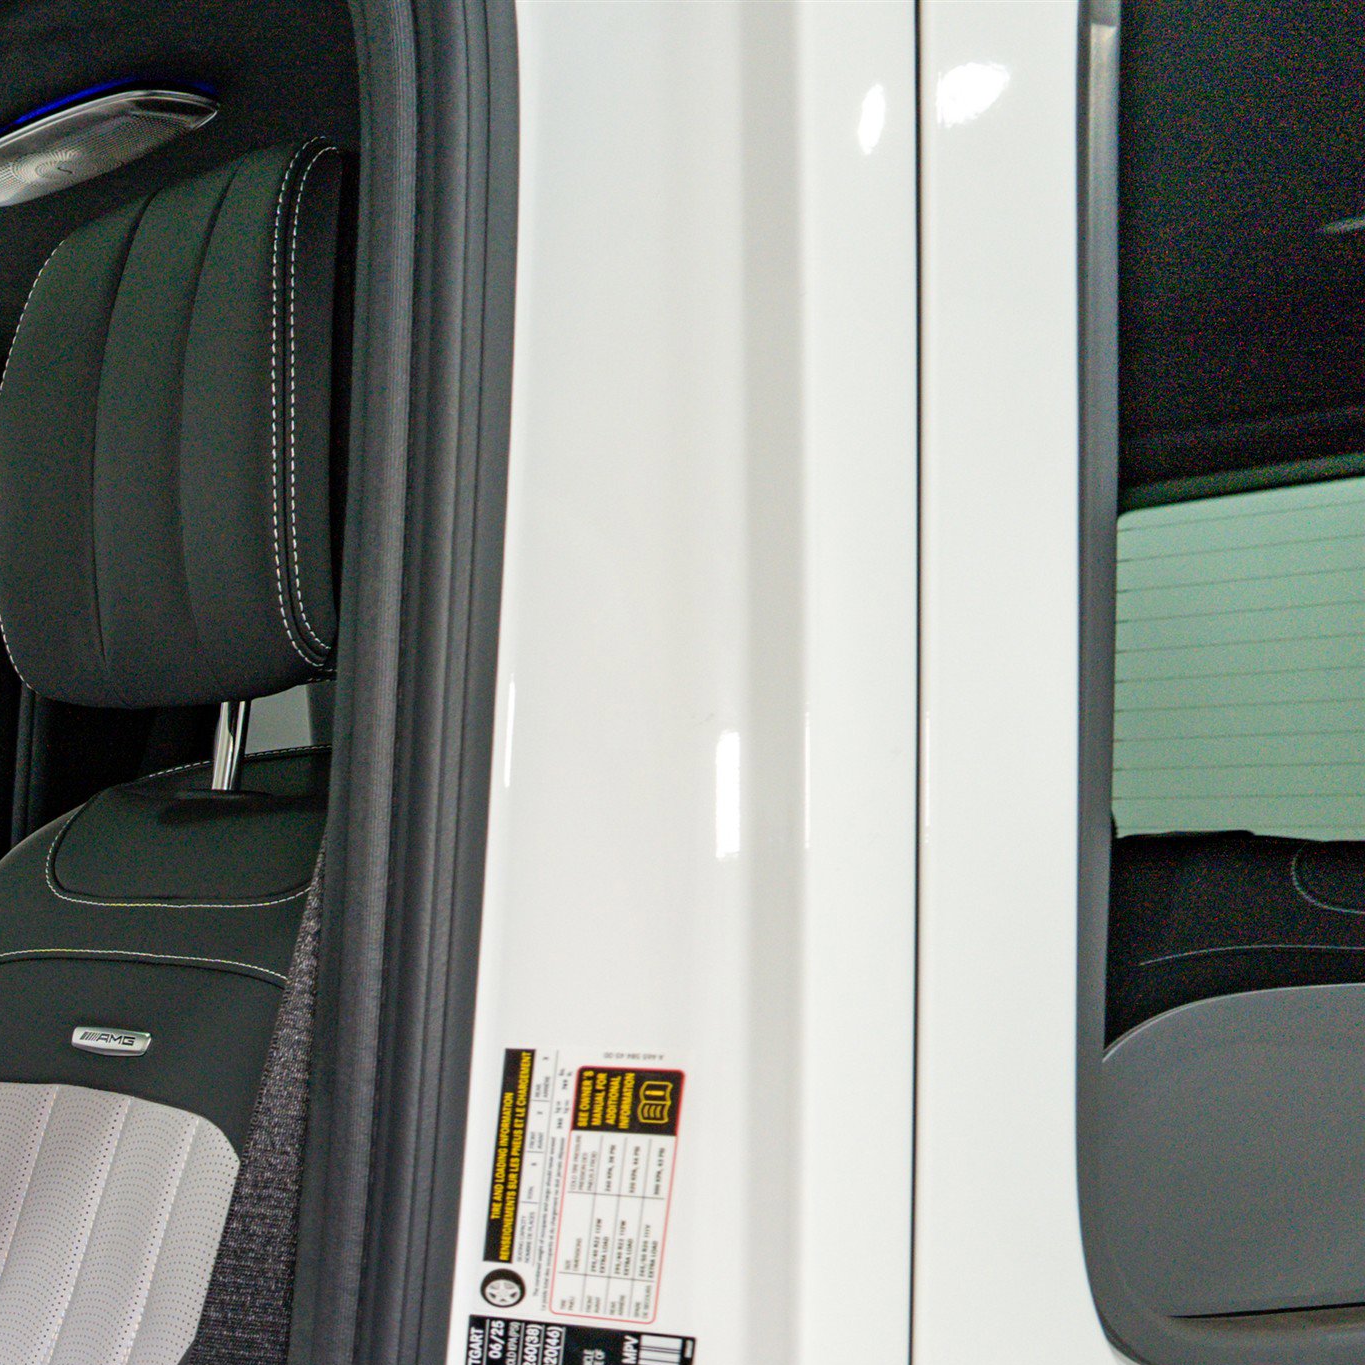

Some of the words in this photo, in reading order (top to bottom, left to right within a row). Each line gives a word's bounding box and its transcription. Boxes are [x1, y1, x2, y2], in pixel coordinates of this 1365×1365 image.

[96, 1033, 136, 1046] AMG
[516, 1052, 531, 1106] CHARGEMENT
[596, 1073, 608, 1090] FOR
[591, 1091, 606, 1126] MANUAL
[605, 1076, 622, 1124] ADDITIONAL
[619, 1073, 636, 1129] INFORMATION
[499, 1092, 514, 1146] INFORMATION
[515, 1107, 525, 1117] LE
[577, 1112, 589, 1127] SEE
[514, 1119, 524, 1128] ET
[511, 1129, 523, 1156] PNEUS
[495, 1148, 508, 1182] LOADING
[509, 1158, 520, 1172] LES
[493, 1184, 504, 1201] AND
[507, 1174, 518, 1189] SUR
[491, 1203, 502, 1219] TIRE
[500, 1191, 516, 1260] RENSEIGNEMENTS
[489, 1320, 507, 1360] 06/25
[622, 1335, 639, 1365] MPV
[594, 1349, 605, 1360] OF
